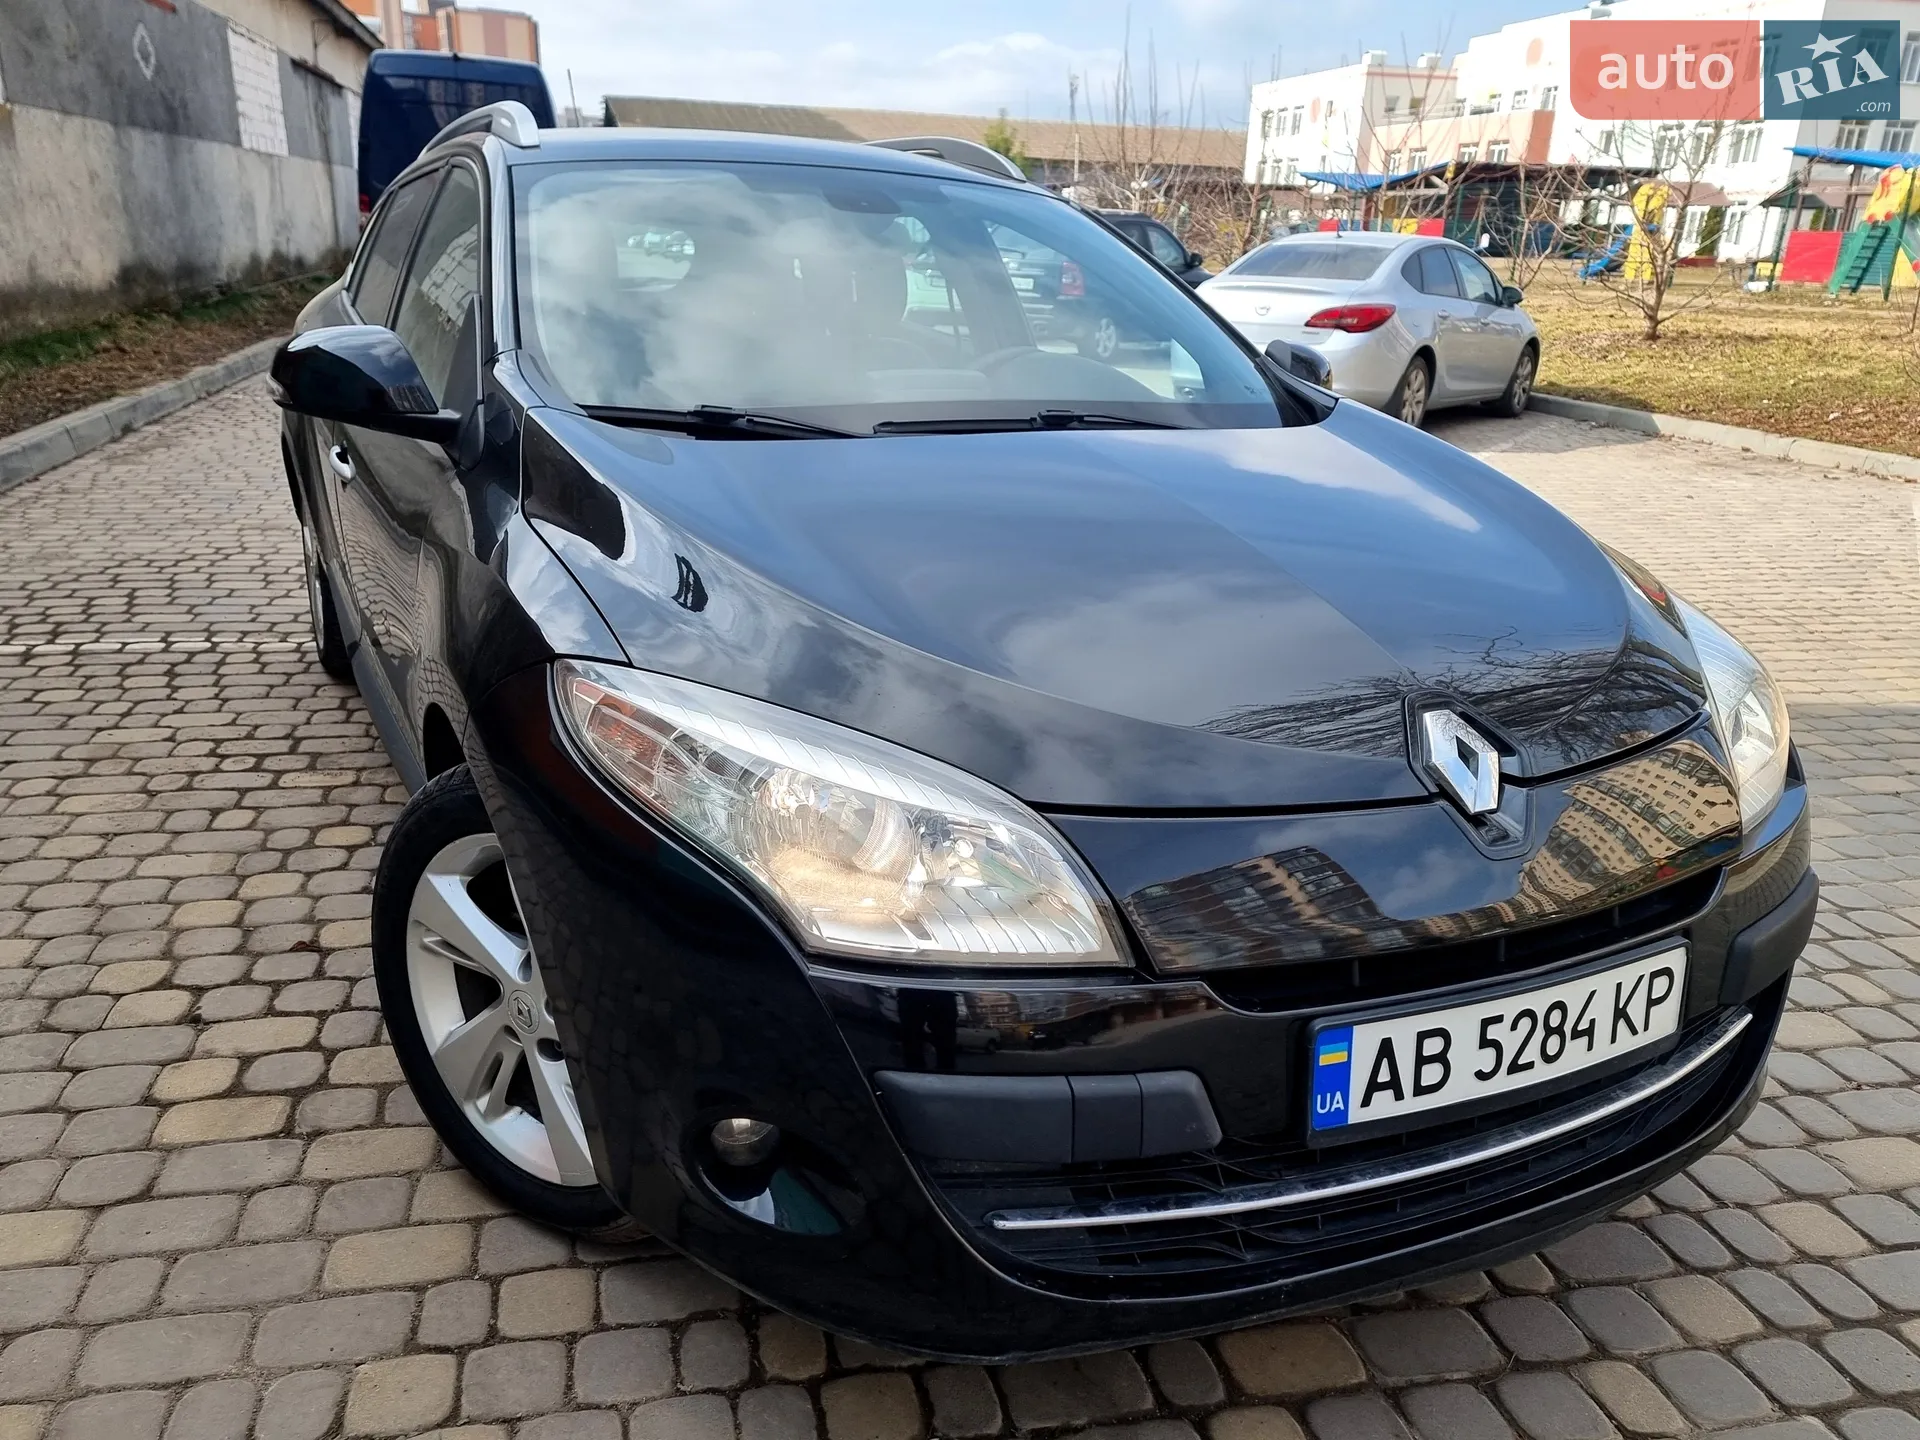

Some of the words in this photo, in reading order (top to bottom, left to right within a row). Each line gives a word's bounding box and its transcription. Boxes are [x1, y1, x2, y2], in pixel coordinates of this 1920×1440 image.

[1360, 1026, 1452, 1108] AB
[1474, 989, 1597, 1082] 5284
[1610, 966, 1675, 1044] KP
[1316, 1090, 1344, 1114] UA
